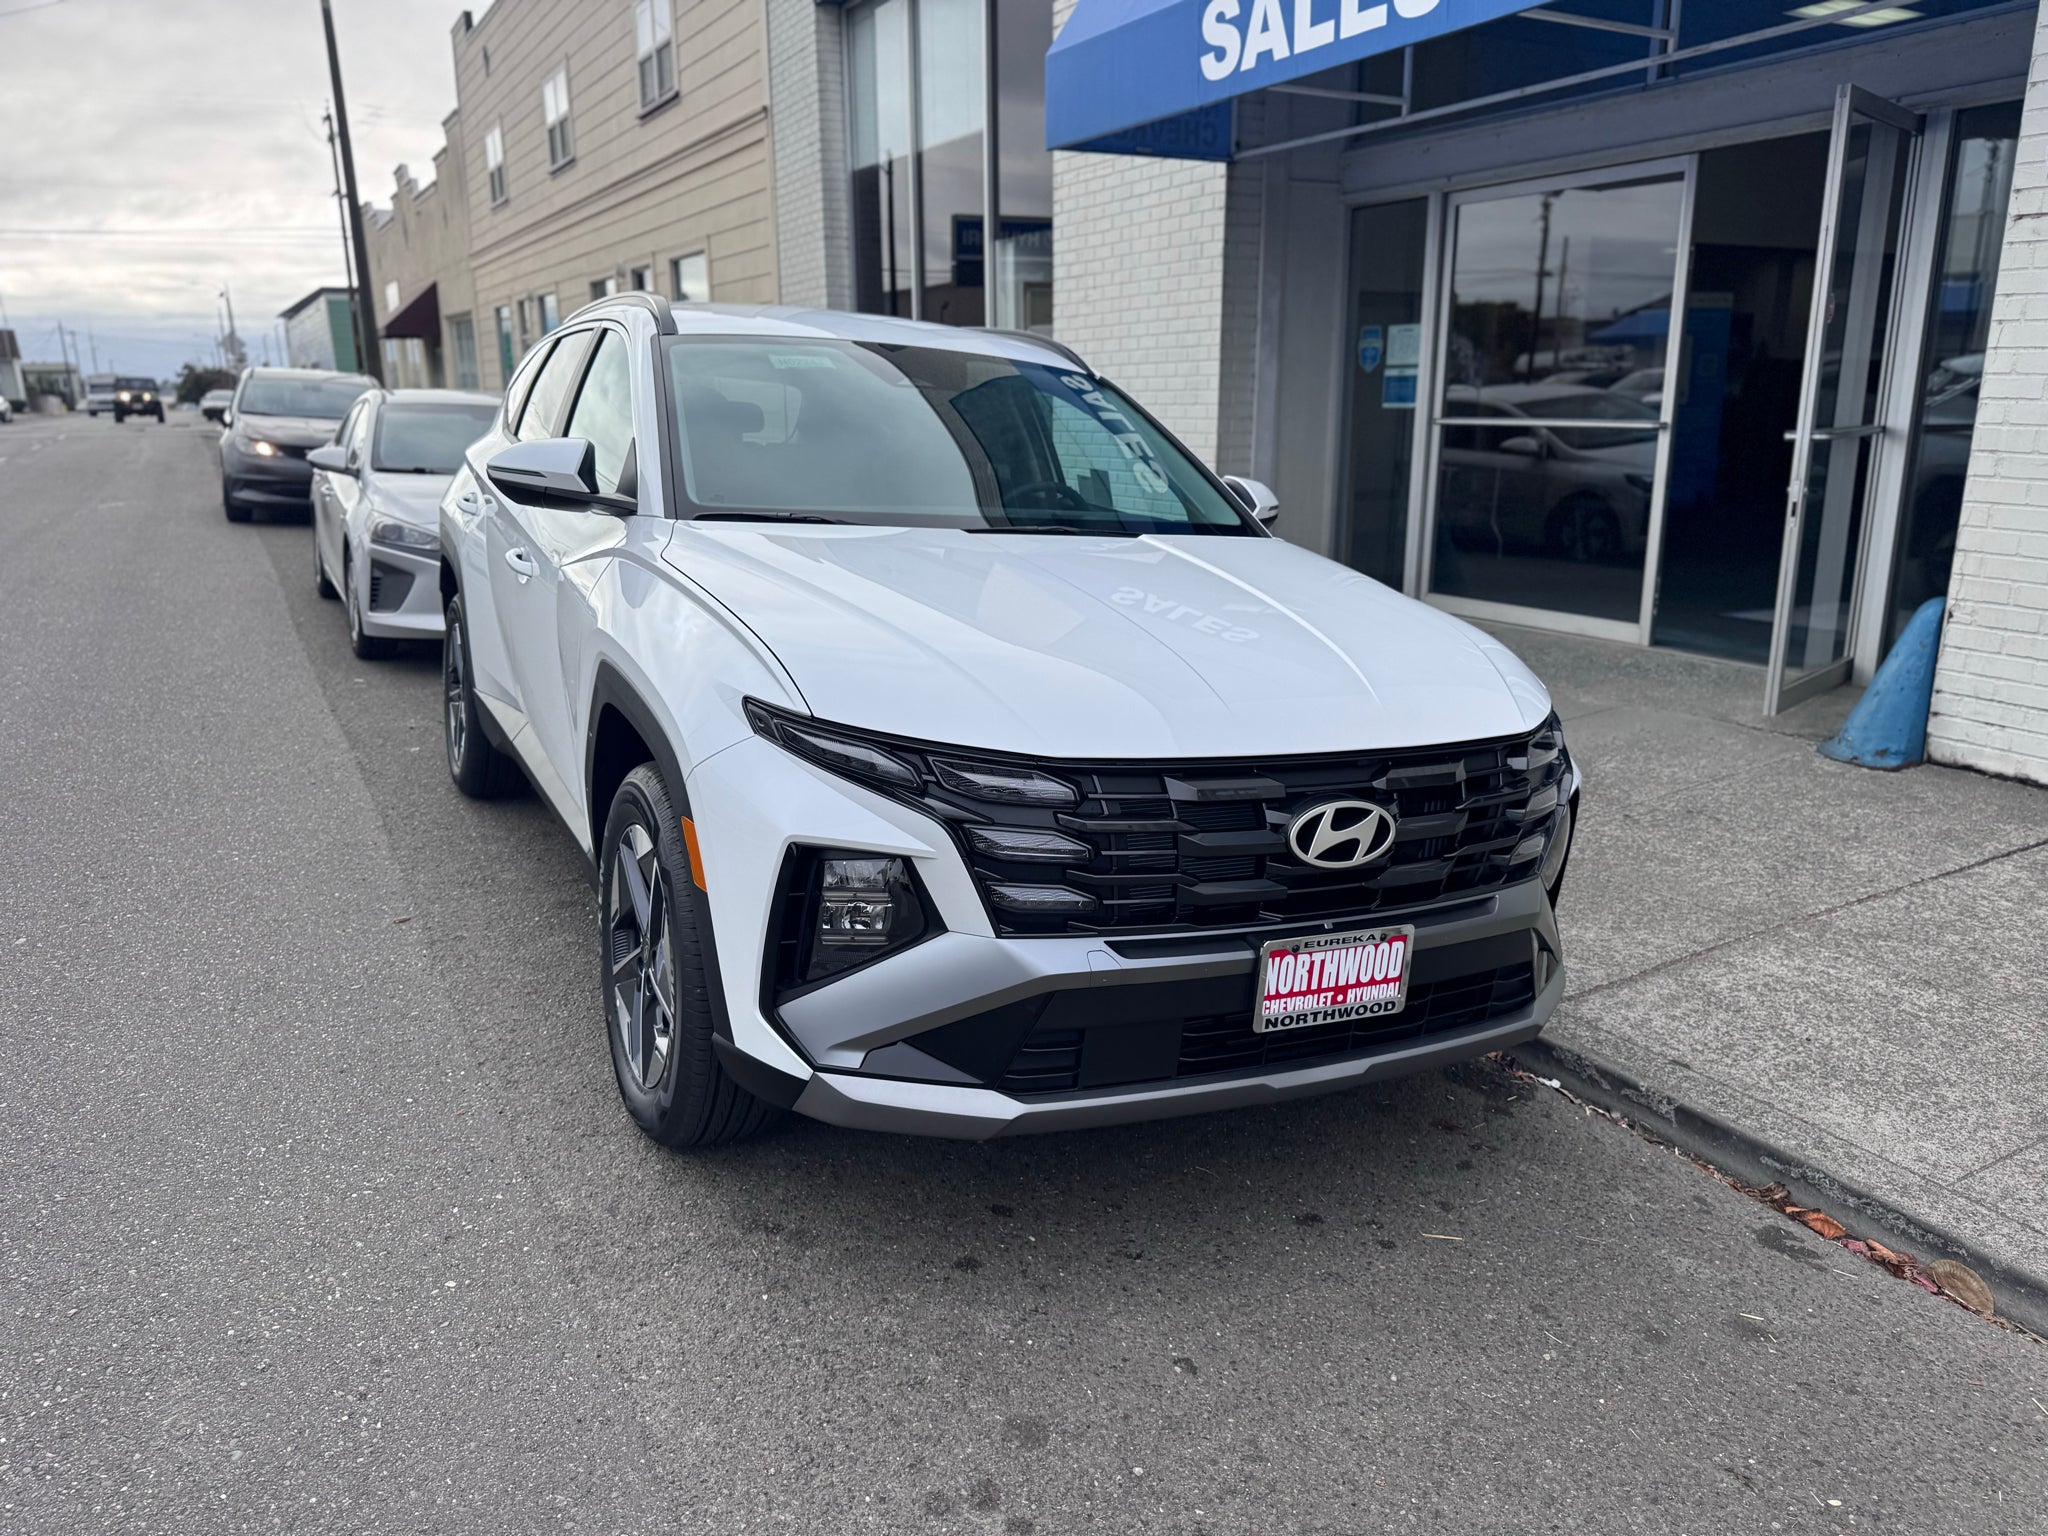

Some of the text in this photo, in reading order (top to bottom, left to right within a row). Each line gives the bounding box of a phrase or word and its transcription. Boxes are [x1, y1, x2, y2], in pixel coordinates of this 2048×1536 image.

[1200, 0, 1440, 81] SAL
[1304, 934, 1377, 948] EUREKA
[1264, 940, 1407, 996] NORTHWOOD
[1262, 981, 1400, 1015] CHEVROLET HYUNDAI
[1264, 1000, 1397, 1030] NORTHWOOD
